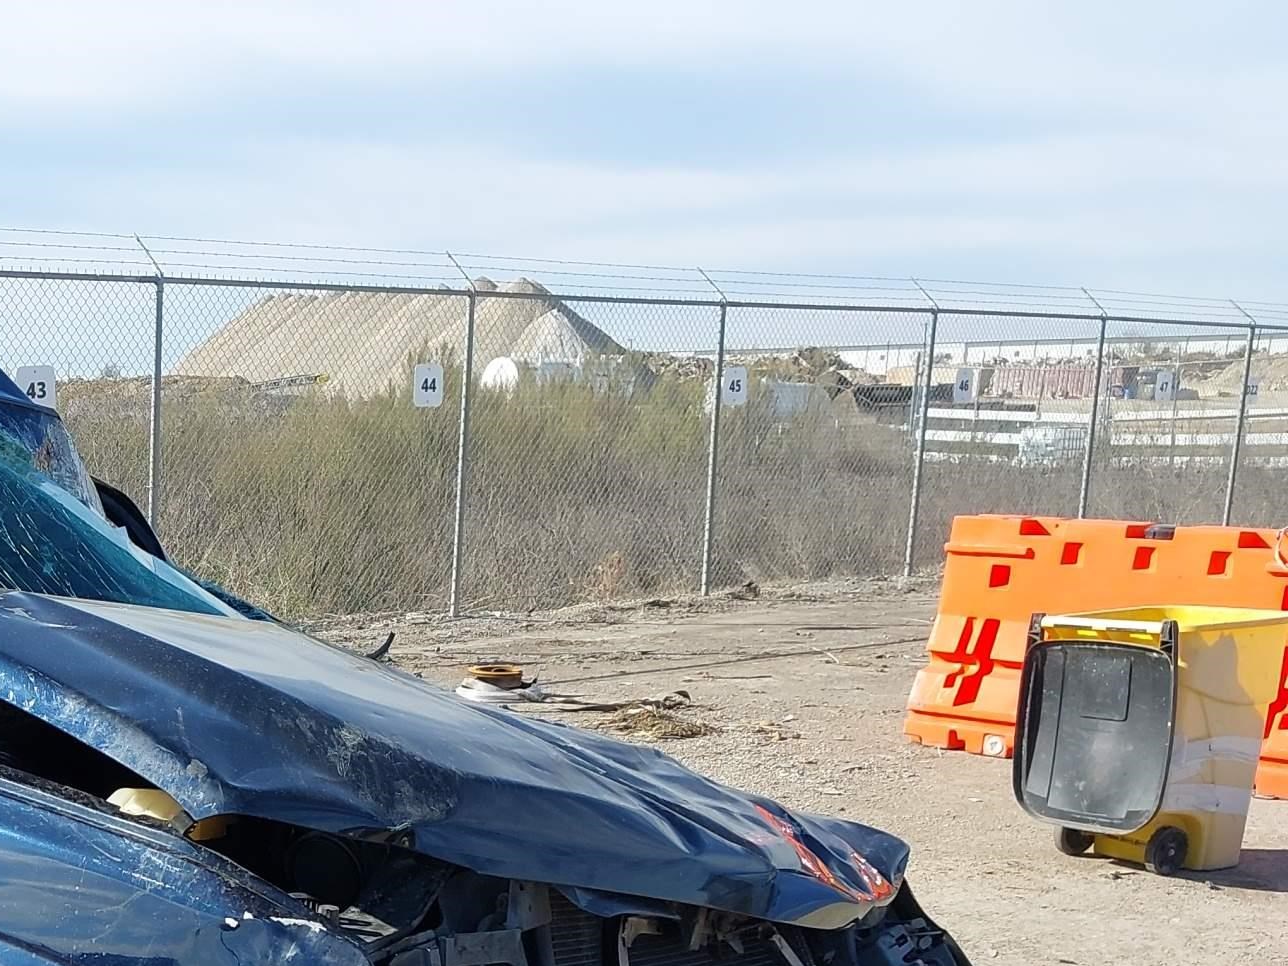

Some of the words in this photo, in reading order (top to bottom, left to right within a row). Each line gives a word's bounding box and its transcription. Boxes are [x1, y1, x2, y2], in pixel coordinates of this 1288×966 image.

[26, 381, 47, 400] 43
[420, 377, 438, 393] 44
[728, 379, 742, 393] 45
